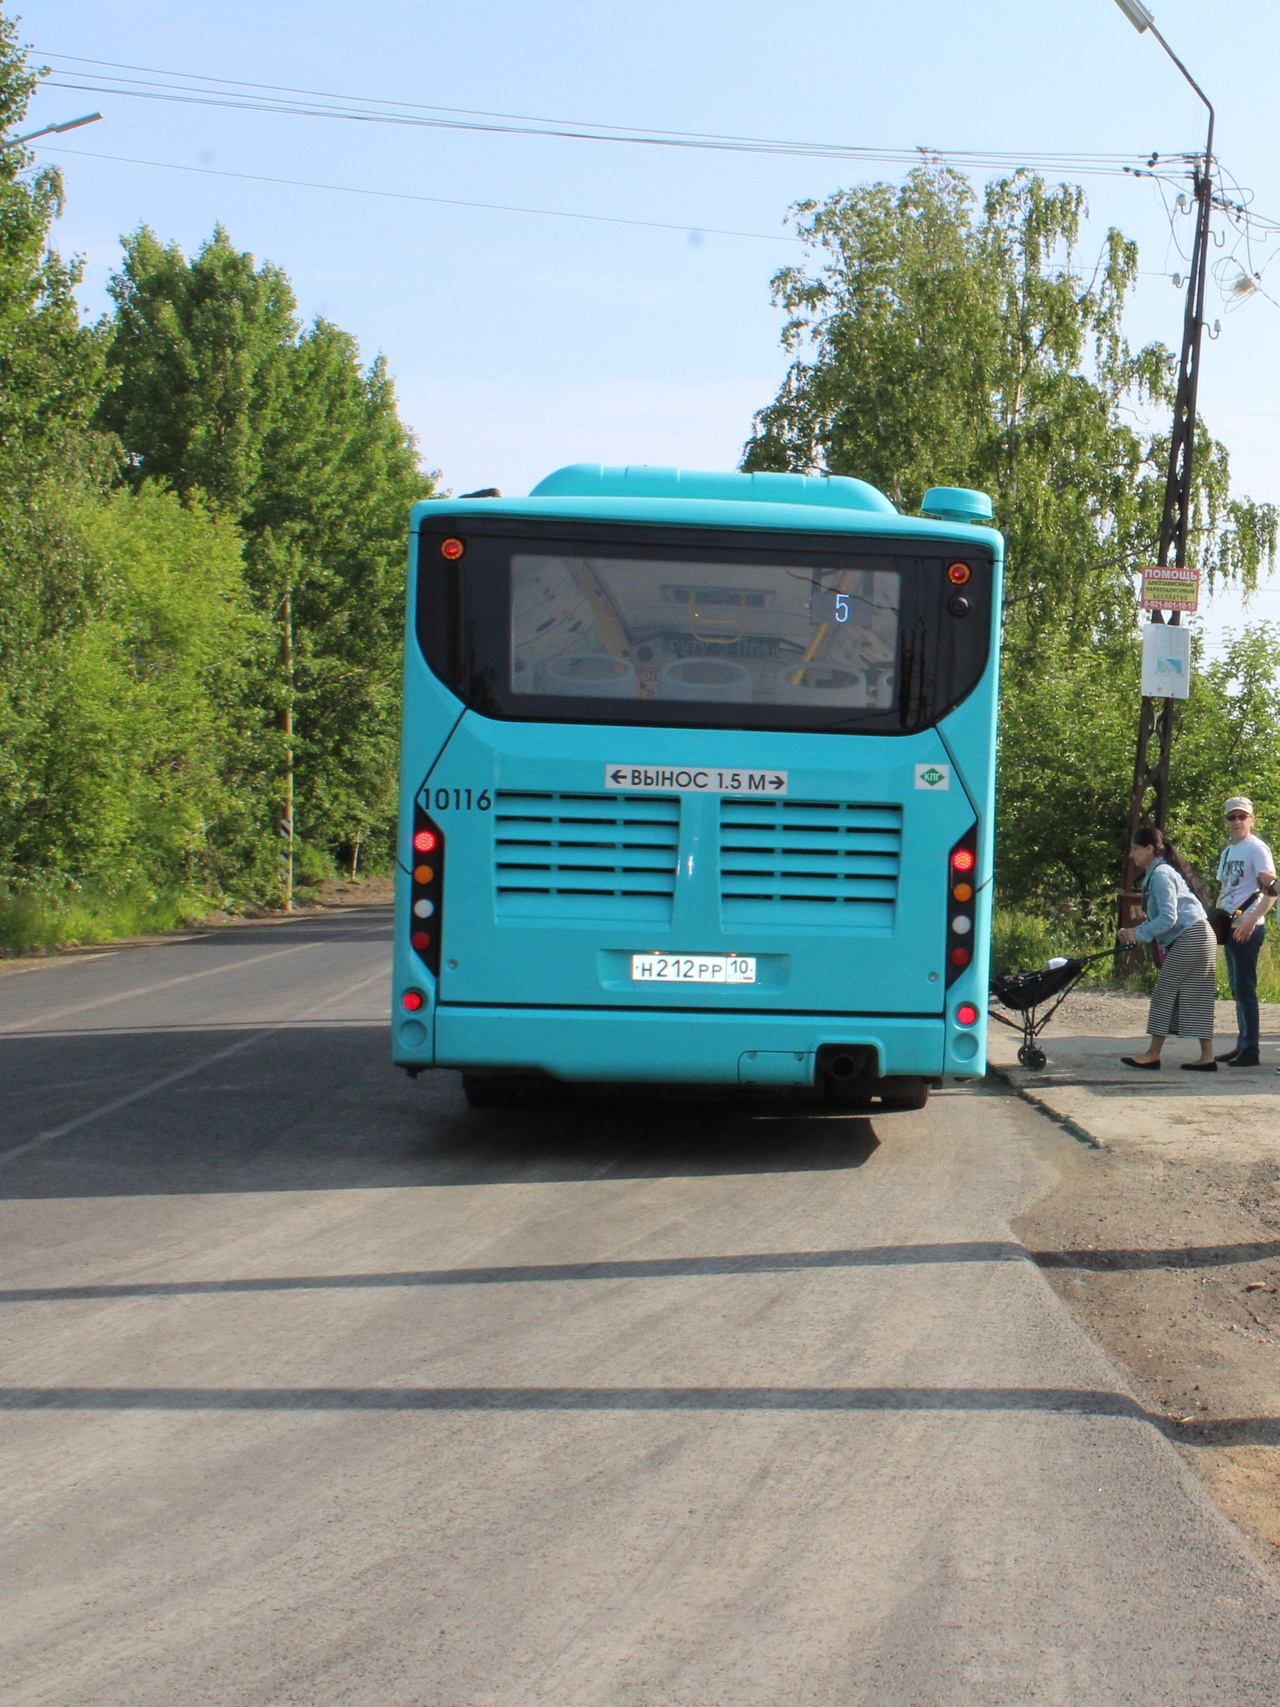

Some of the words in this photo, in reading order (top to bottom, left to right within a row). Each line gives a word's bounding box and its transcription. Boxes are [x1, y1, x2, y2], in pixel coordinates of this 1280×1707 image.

[1145, 569, 1197, 581] ПОМОЩЬ
[835, 594, 849, 623] 5
[631, 769, 709, 788] ВЫНОС
[717, 773, 742, 790] 1.5
[748, 774, 766, 791] М
[924, 772, 941, 782] КПГ
[423, 788, 492, 811] 10116
[730, 959, 749, 974] 10
